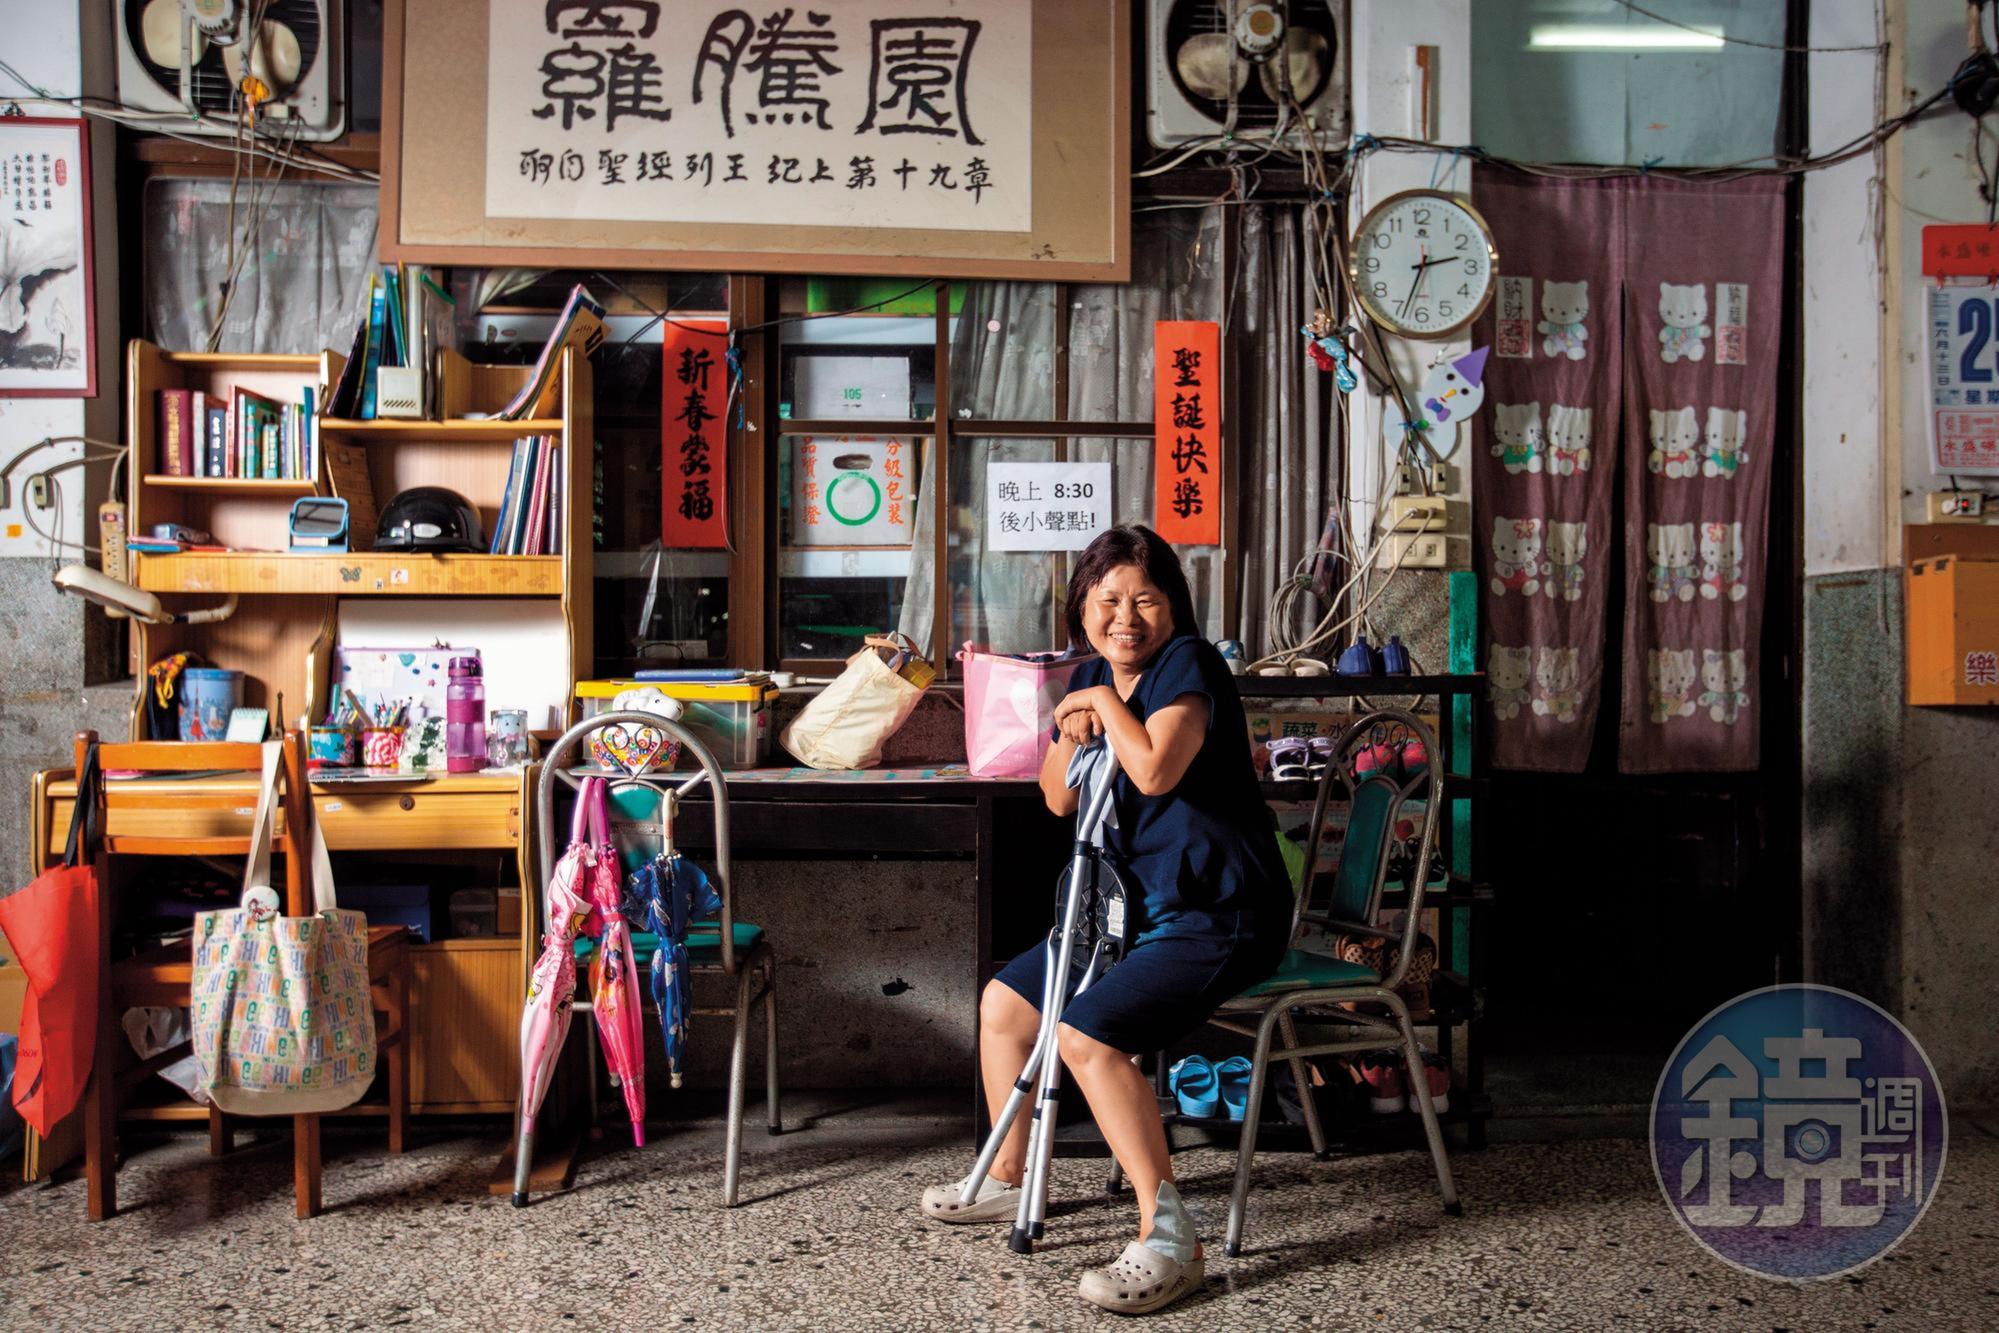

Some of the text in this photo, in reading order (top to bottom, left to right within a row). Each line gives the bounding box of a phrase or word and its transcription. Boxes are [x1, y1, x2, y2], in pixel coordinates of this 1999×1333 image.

[1389, 218, 1402, 232] 11
[1413, 209, 1431, 225] 12
[1444, 218, 1449, 232] 1
[1371, 233, 1391, 249] 10
[1454, 234, 1468, 250] 2
[1364, 257, 1380, 273] 9
[1464, 259, 1478, 275] 3
[1373, 282, 1387, 298] 8
[1457, 283, 1470, 298] 4
[1391, 300, 1404, 316] 7
[1415, 307, 1429, 323] 6
[1439, 301, 1453, 317] 5
[1958, 297, 1999, 383] 2
[843, 388, 862, 400] 105
[674, 347, 719, 521] 新春蒙福
[1171, 347, 1208, 519] 聖誕快樂
[801, 436, 822, 526] 品質保證
[884, 437, 904, 526] 分級包裝
[998, 481, 1094, 502] 晚上 8:30
[1000, 511, 1096, 533] 後小聲點!
[1966, 652, 1997, 684] 樂
[1282, 721, 1362, 739] 蔬菜·水
